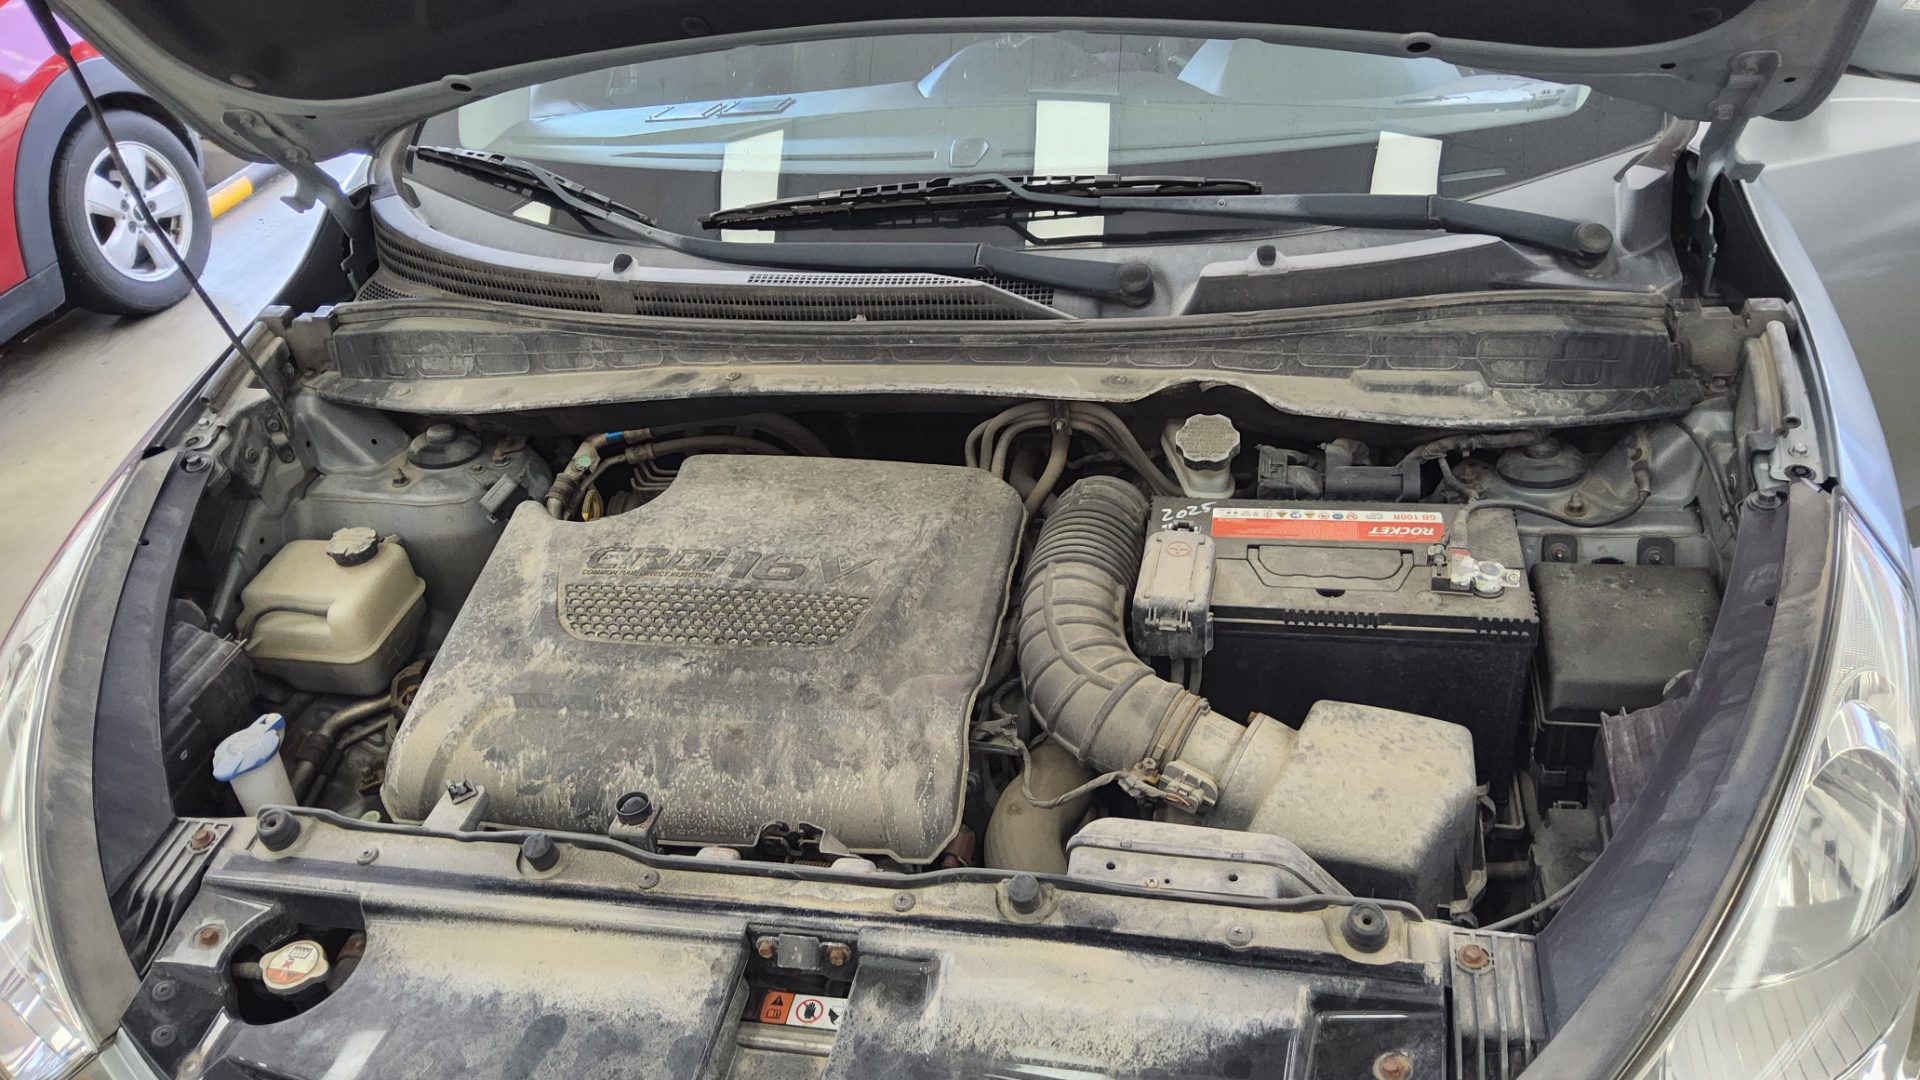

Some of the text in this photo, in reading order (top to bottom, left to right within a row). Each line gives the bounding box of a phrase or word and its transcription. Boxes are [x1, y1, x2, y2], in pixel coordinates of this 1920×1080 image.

[1161, 501, 1218, 521] 2025
[1368, 525, 1435, 536] ROCKET
[581, 568, 619, 577] COMMON
[639, 570, 671, 578] DIRECT
